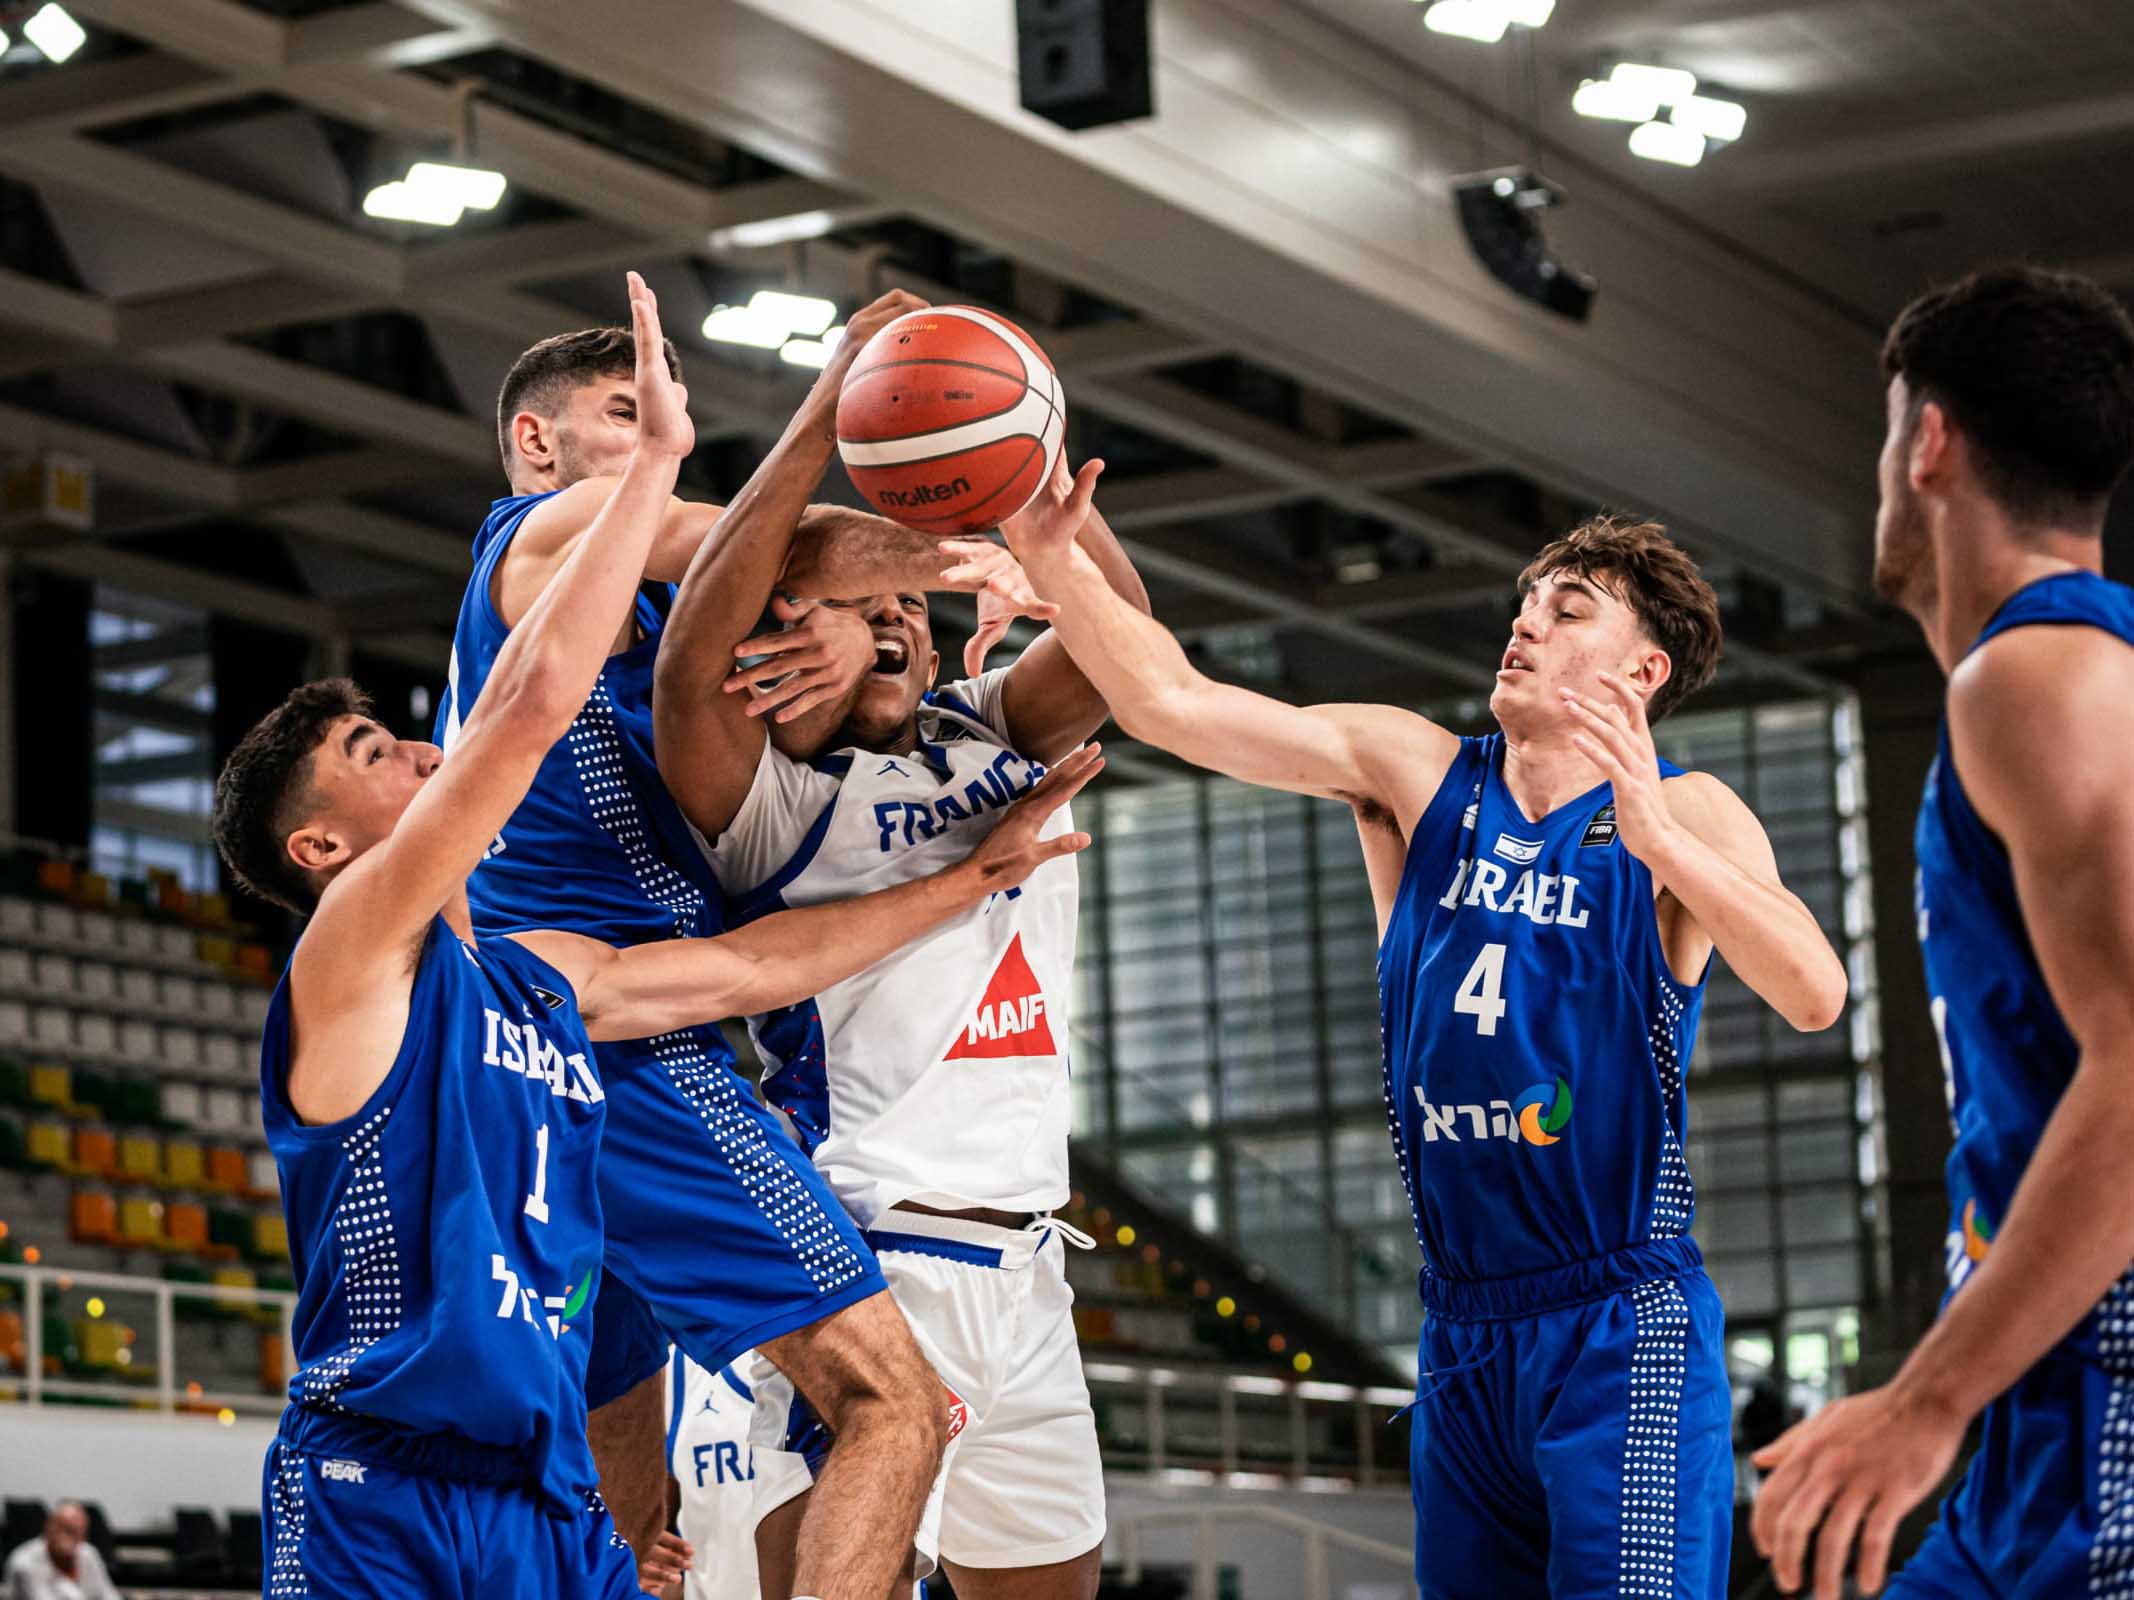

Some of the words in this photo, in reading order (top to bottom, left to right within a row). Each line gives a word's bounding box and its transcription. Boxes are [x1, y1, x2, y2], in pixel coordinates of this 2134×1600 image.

[878, 477, 972, 507] molten
[1438, 857, 1590, 929] IRAEL
[966, 992, 1047, 1046] MAIF
[1454, 942, 1507, 1037] 4
[523, 1123, 550, 1225] 1
[320, 1458, 368, 1485] PEAK
